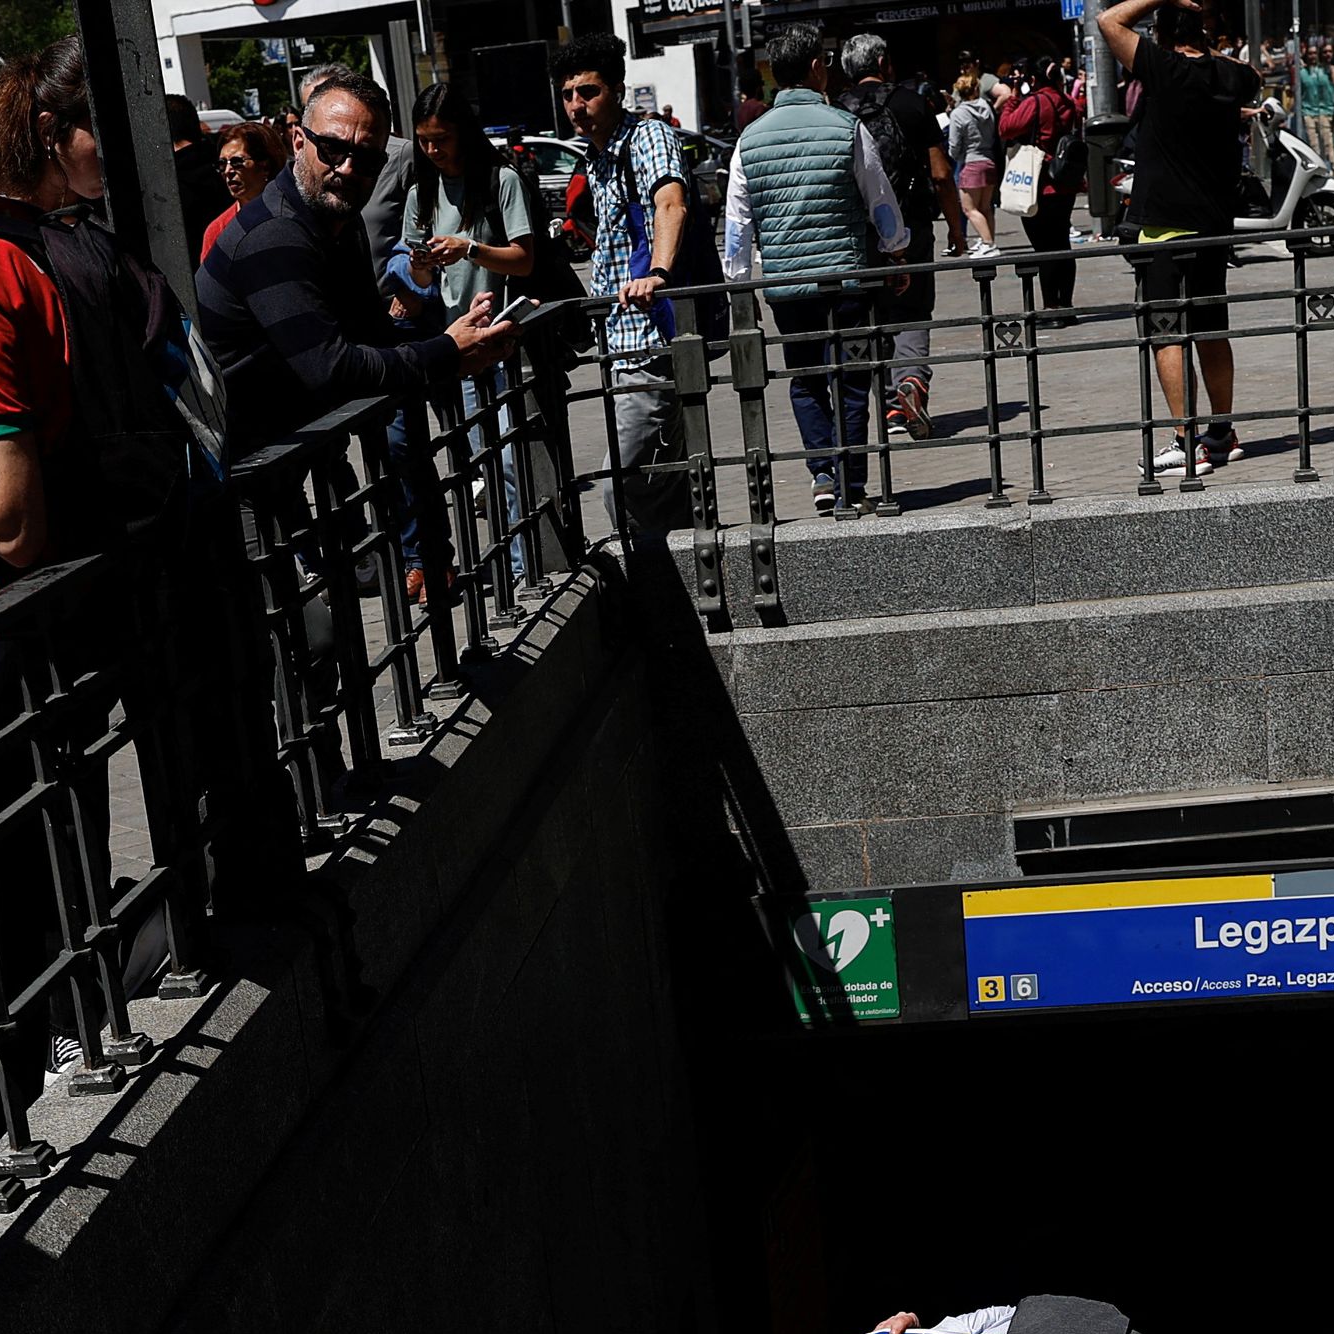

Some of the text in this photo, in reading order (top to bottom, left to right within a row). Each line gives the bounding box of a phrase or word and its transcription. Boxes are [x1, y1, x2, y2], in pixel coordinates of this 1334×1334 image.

[875, 6, 940, 21] CERVECERIA
[1005, 169, 1034, 186] Cipla
[844, 981, 878, 992] dotada
[880, 980, 893, 990] de
[985, 979, 999, 999] 3
[1017, 977, 1032, 997] 6
